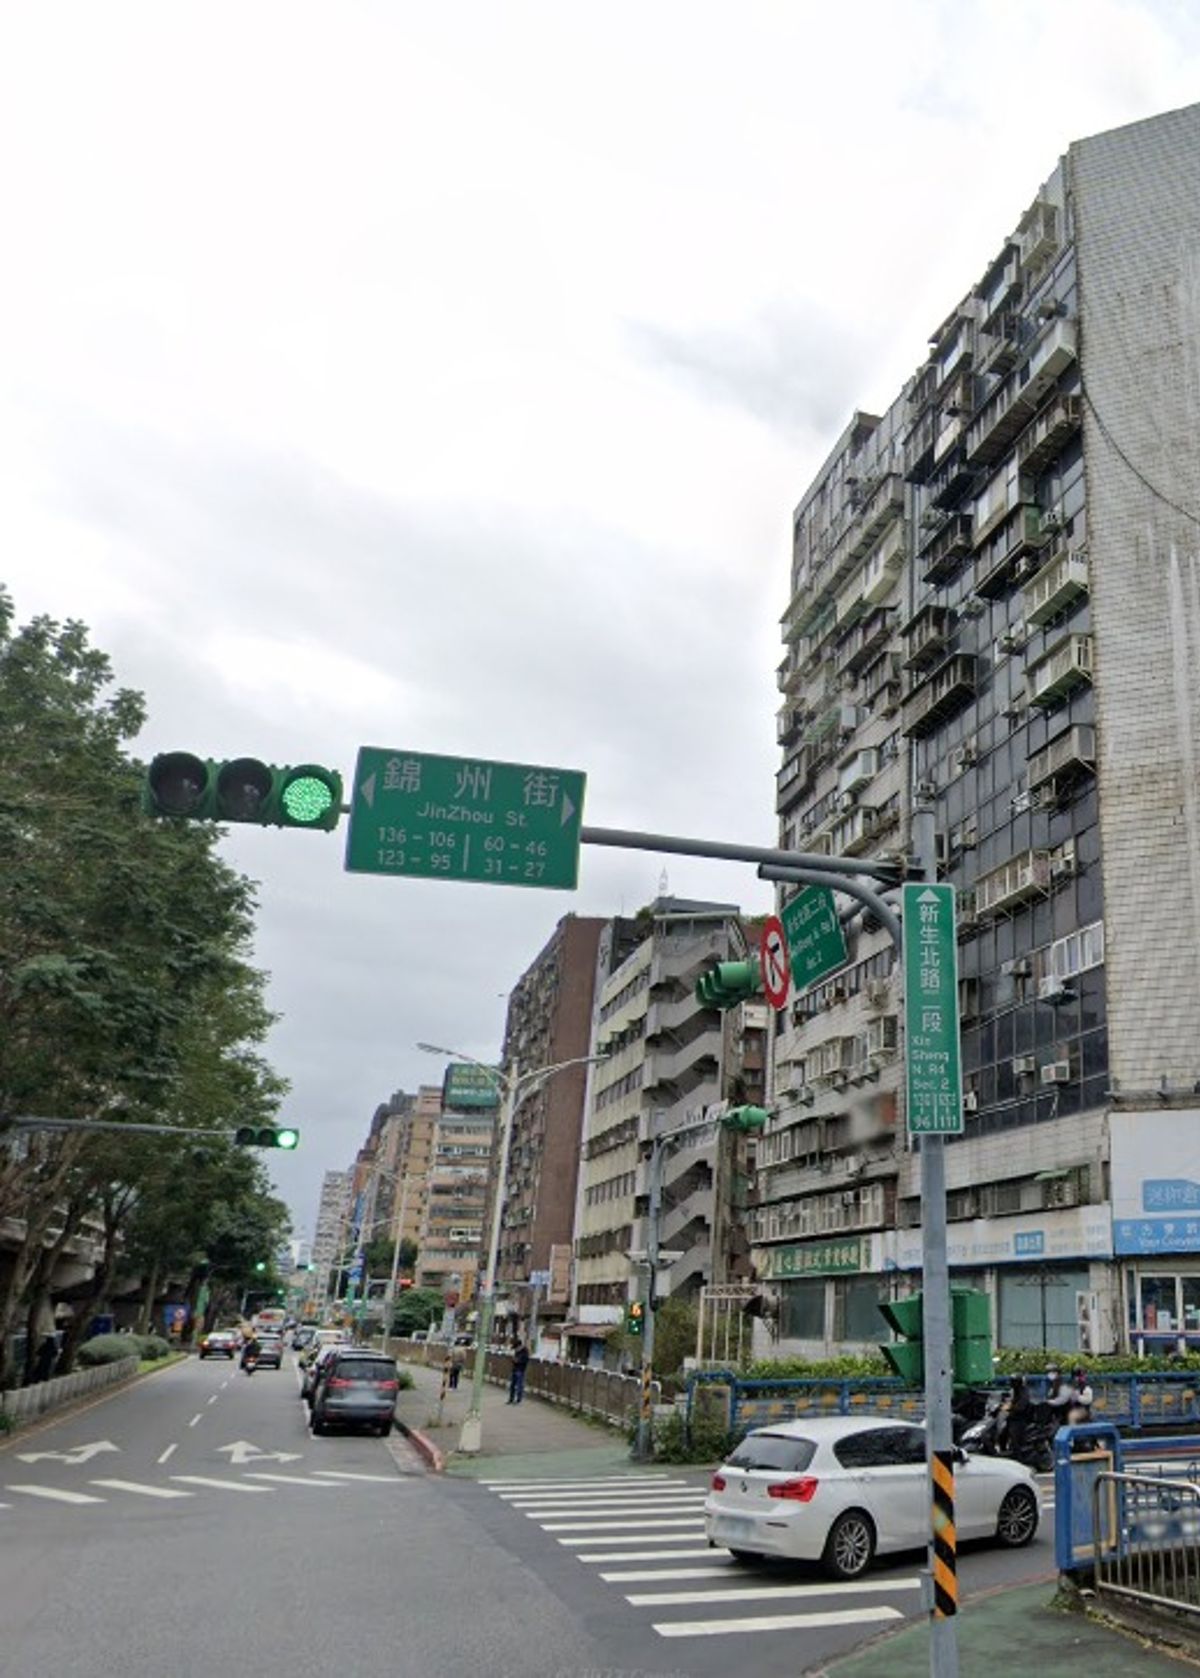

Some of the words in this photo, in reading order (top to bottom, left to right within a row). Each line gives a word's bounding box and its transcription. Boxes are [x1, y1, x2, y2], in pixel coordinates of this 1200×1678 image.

[382, 757, 559, 807] 錦州街
[417, 801, 494, 824] JinZhou
[506, 811, 527, 827] St
[919, 904, 943, 1032] 新生北路二段
[911, 1049, 950, 1063] Sheng
